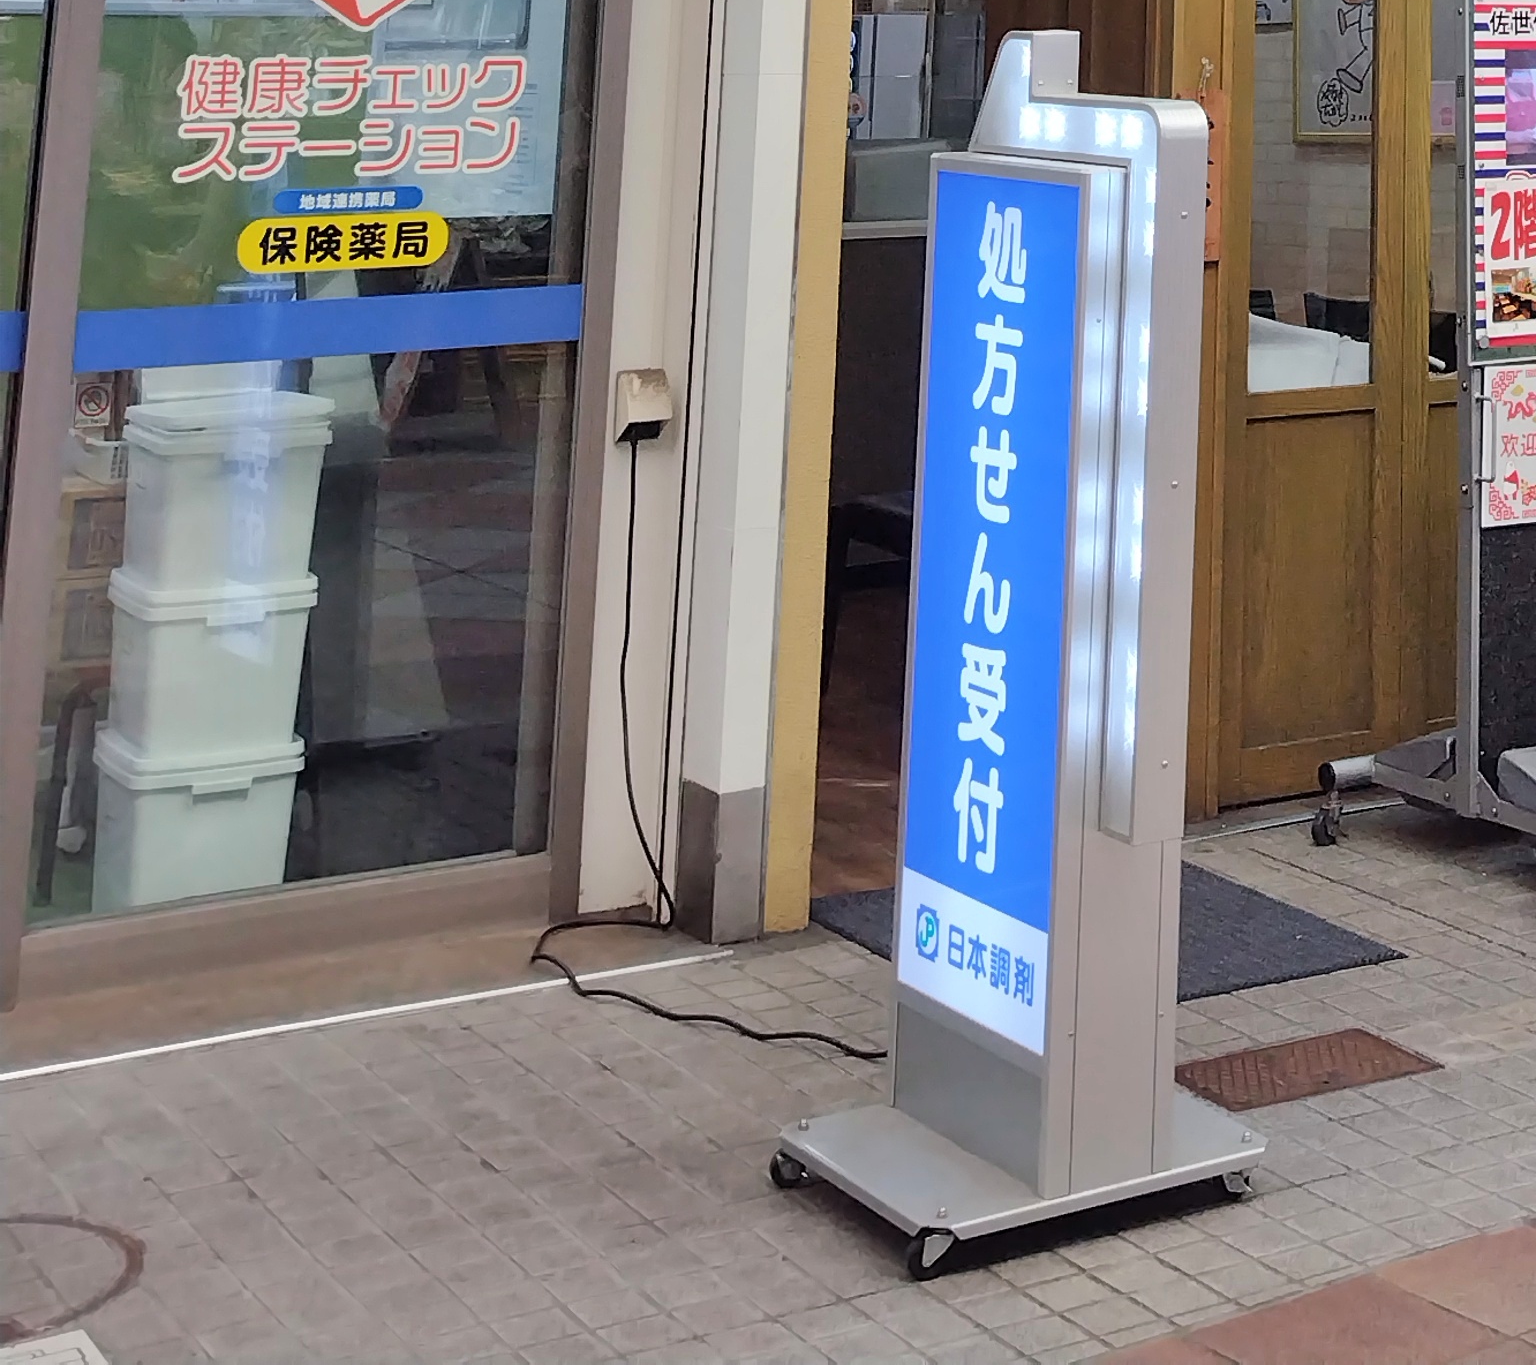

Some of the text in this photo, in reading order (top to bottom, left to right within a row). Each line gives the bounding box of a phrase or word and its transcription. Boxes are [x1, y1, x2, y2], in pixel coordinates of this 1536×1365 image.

[183, 57, 524, 118] 健康チェック
[176, 120, 518, 181] ステーション
[299, 191, 396, 211] 地域連携薬局
[259, 221, 430, 266] 保険薬局
[952, 201, 1026, 876] 処方せん受付
[947, 923, 1035, 1007] 日本調剤
